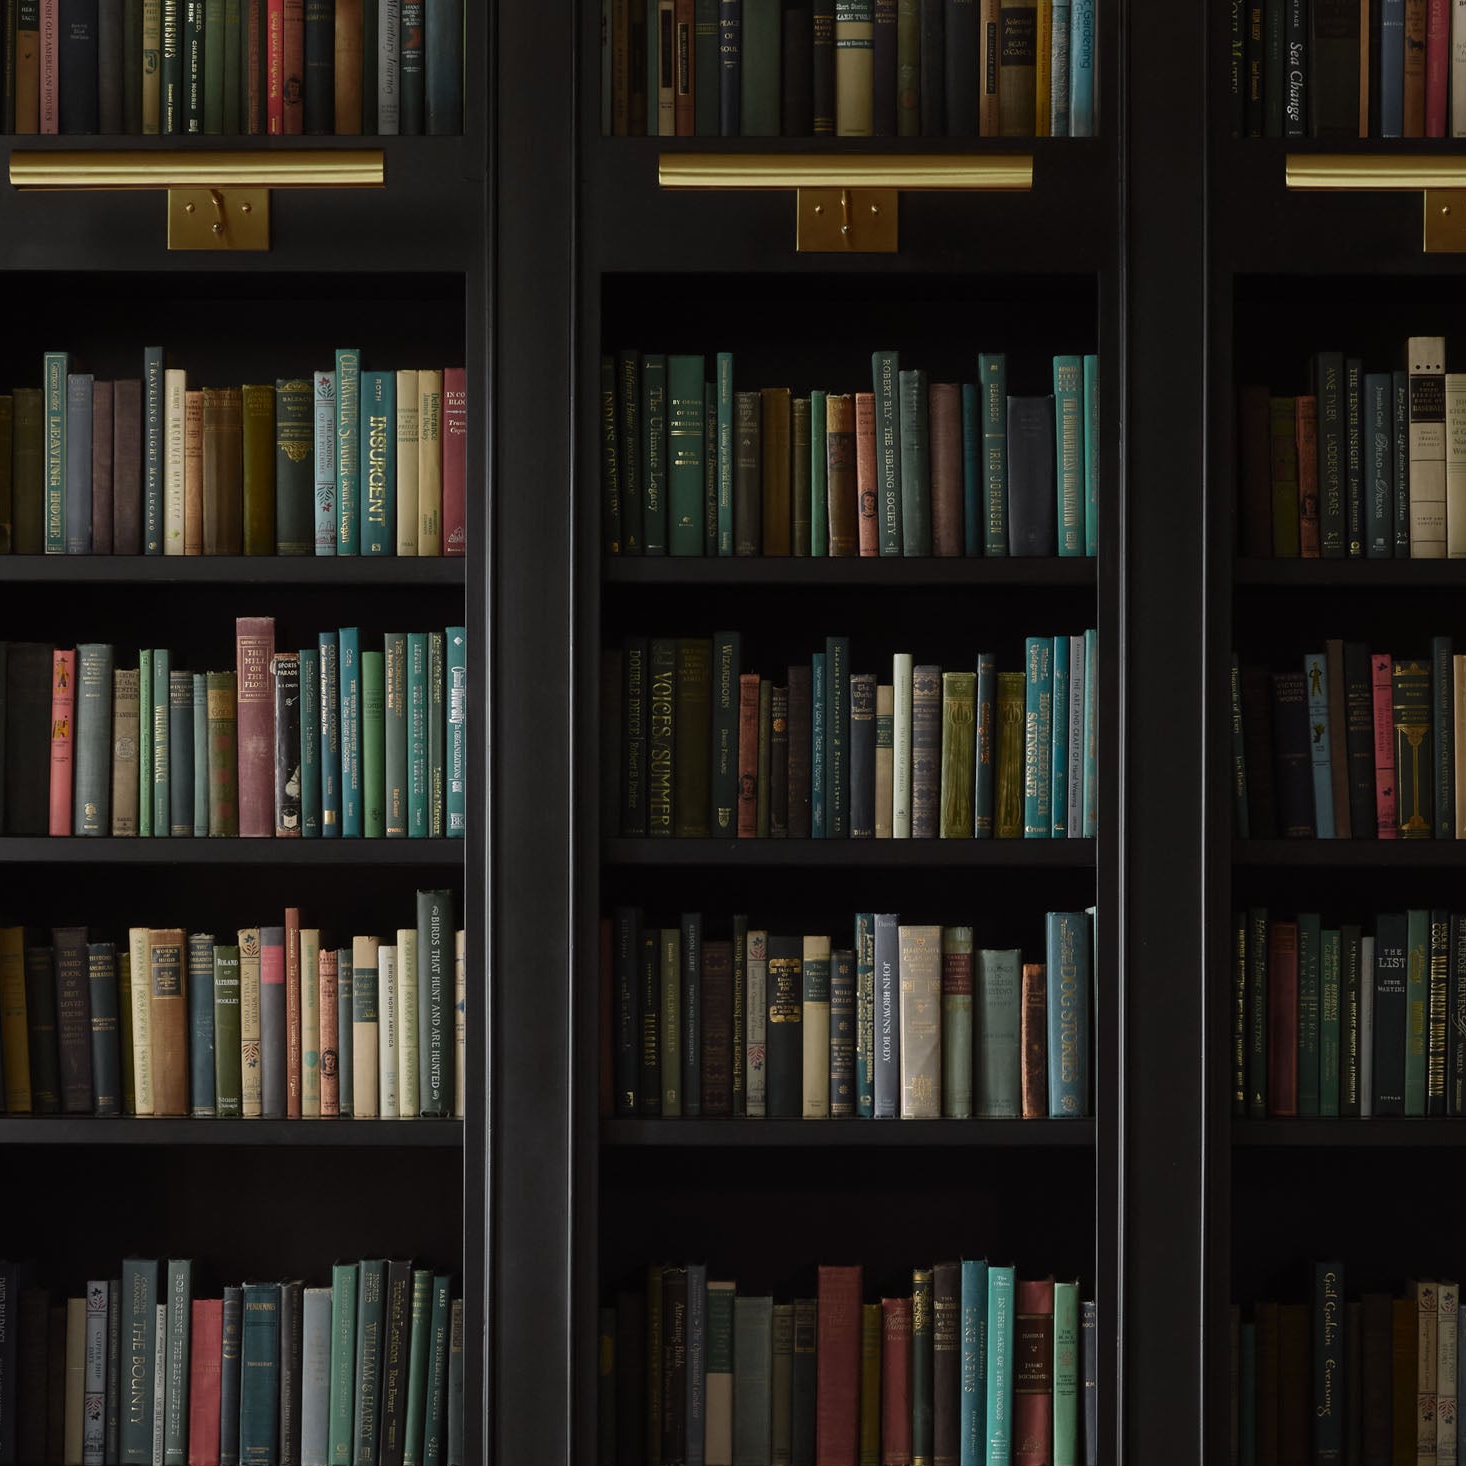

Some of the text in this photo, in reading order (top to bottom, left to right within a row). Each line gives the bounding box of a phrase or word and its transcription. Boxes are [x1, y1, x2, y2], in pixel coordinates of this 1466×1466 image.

[1286, 42, 1303, 121] Sea Change
[339, 354, 357, 475] CLEARWATER SUMMER
[431, 393, 439, 440] Deliverance
[882, 359, 892, 419] ROBERT BLY
[1326, 368, 1336, 421] ANNE TYLER
[50, 416, 61, 538] LEAVING HOME
[369, 416, 387, 526] INSURGENT
[648, 388, 662, 512] The Ultimate Legacy
[885, 427, 895, 534] THE SIBLING SOCIETY
[1327, 434, 1338, 515] LADDER OF YEARS
[1350, 428, 1359, 470] INSIGHT
[652, 672, 672, 737] VOICES
[155, 705, 166, 783] WILLIAM WALLACE
[1026, 712, 1037, 797] SAVINGS SAFE
[1073, 753, 1079, 762] OF
[651, 750, 670, 826] SUMMER
[388, 986, 393, 994] OF
[1458, 936, 1466, 974] PURPOSE
[431, 917, 440, 1088] BIRDS THAT HUNT AND ARE HUNTED
[883, 961, 891, 1063] JOHN BROWN'S BODY
[1061, 966, 1077, 1083] DOG STORIES
[1458, 977, 1466, 1011] DRIVEN
[997, 1297, 1005, 1307] IN
[997, 1310, 1005, 1328] THE
[1324, 1272, 1338, 1346] Gail Godwin
[131, 1320, 146, 1425] THE BOUNTY
[997, 1331, 1005, 1353] LAKE
[997, 1356, 1005, 1367] OF
[360, 1322, 376, 1441] WILLIAM & HARRY
[1317, 1359, 1336, 1417] Evensong
